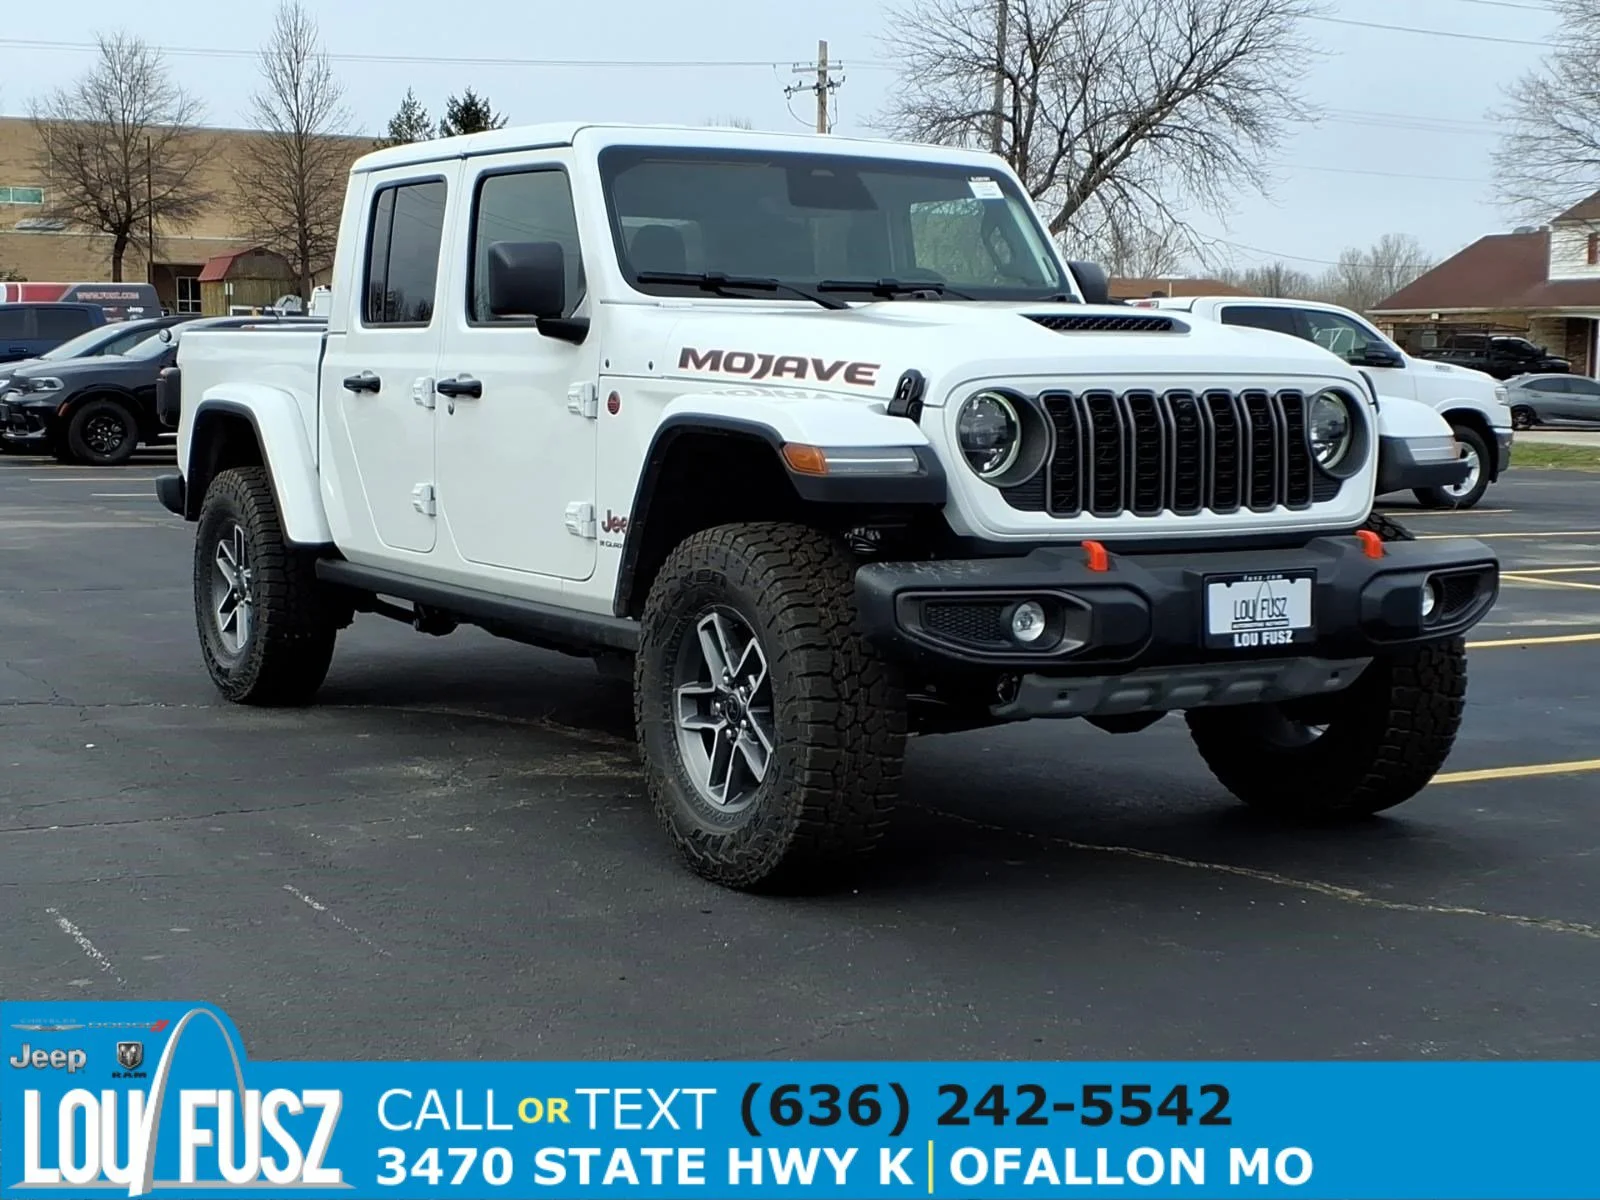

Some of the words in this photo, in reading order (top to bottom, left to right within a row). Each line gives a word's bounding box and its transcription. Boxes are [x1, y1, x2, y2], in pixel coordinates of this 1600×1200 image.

[678, 346, 881, 387] MOJAVE
[601, 509, 628, 534] Jee
[1234, 599, 1256, 620] LOU
[1260, 597, 1287, 618] FUSZ
[1234, 632, 1259, 647] LOU
[1262, 630, 1293, 645] FUSZ
